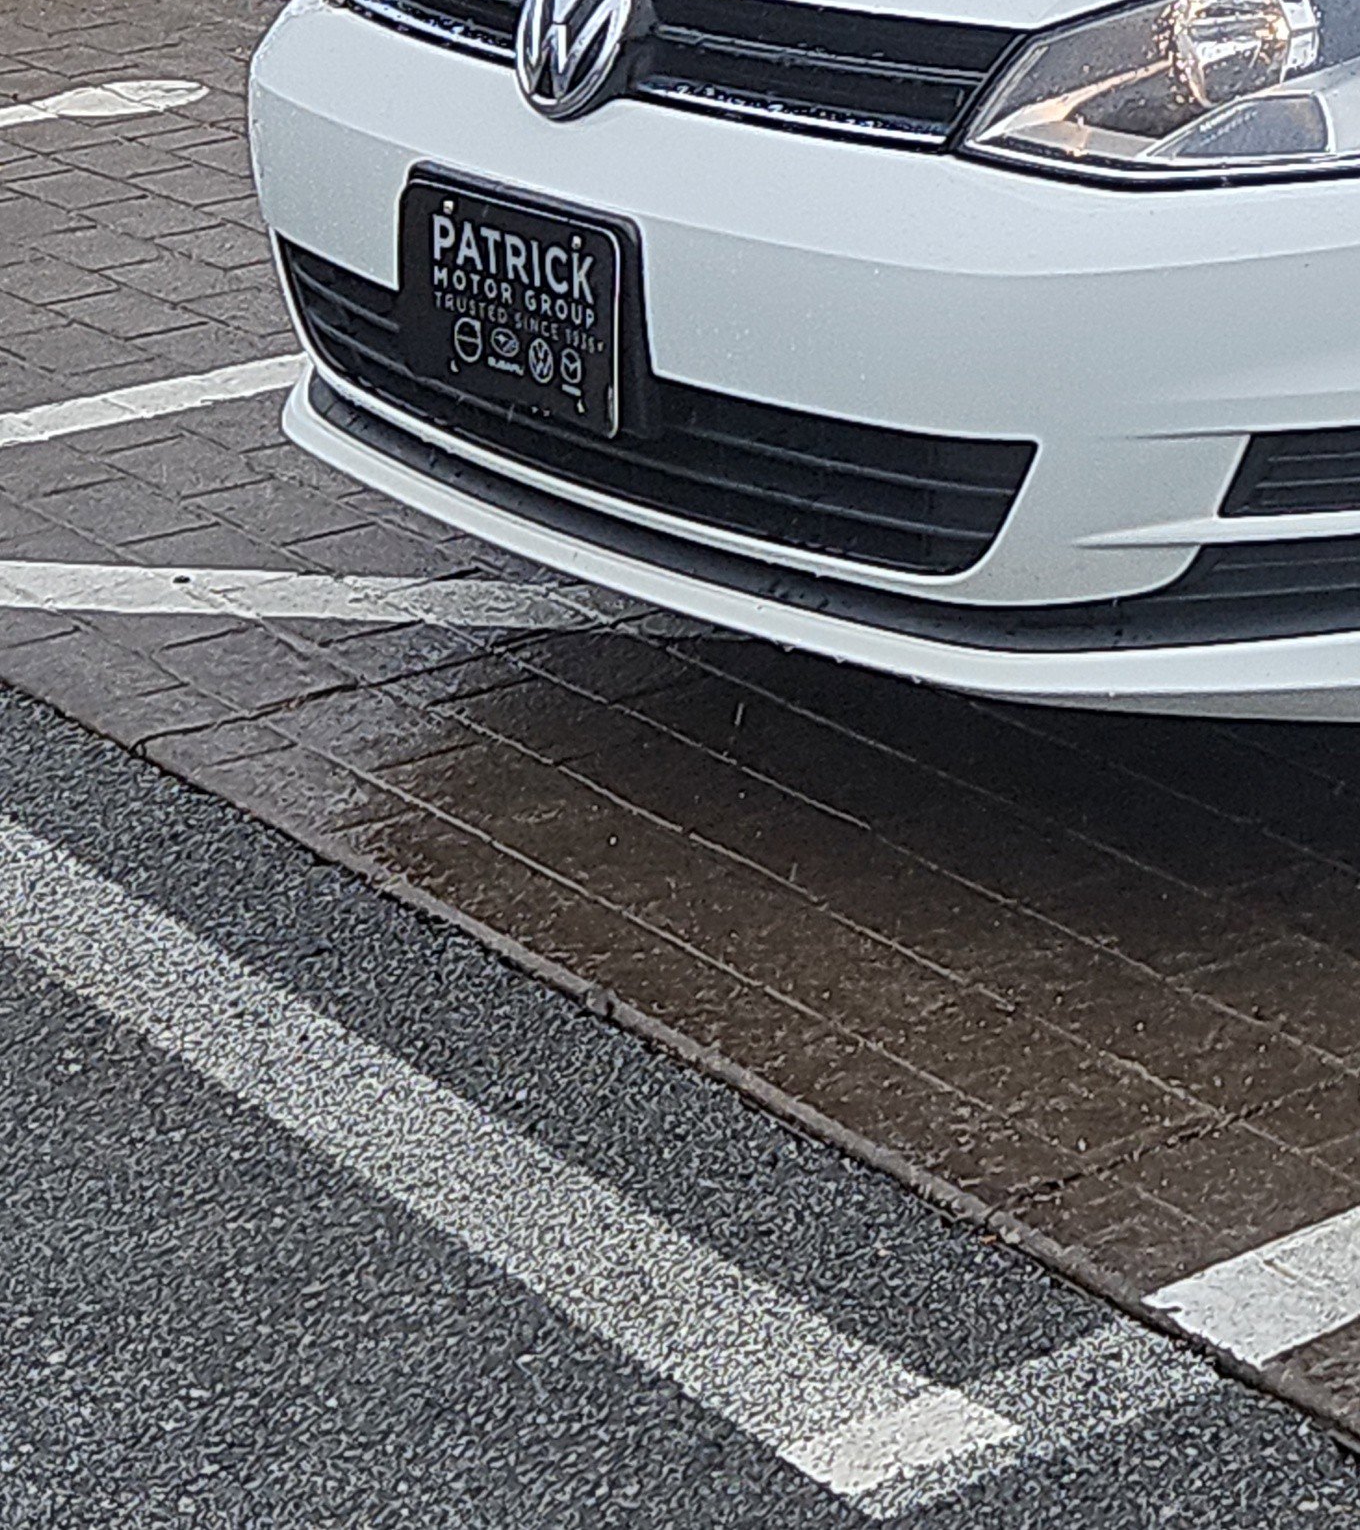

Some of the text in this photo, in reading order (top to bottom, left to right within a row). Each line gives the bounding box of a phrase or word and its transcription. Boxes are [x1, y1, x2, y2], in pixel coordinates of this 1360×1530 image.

[432, 214, 595, 304] PATRICK
[433, 265, 595, 329] MOTOR GROUP
[433, 290, 507, 324] TRUSTED
[514, 312, 559, 341] SINCE
